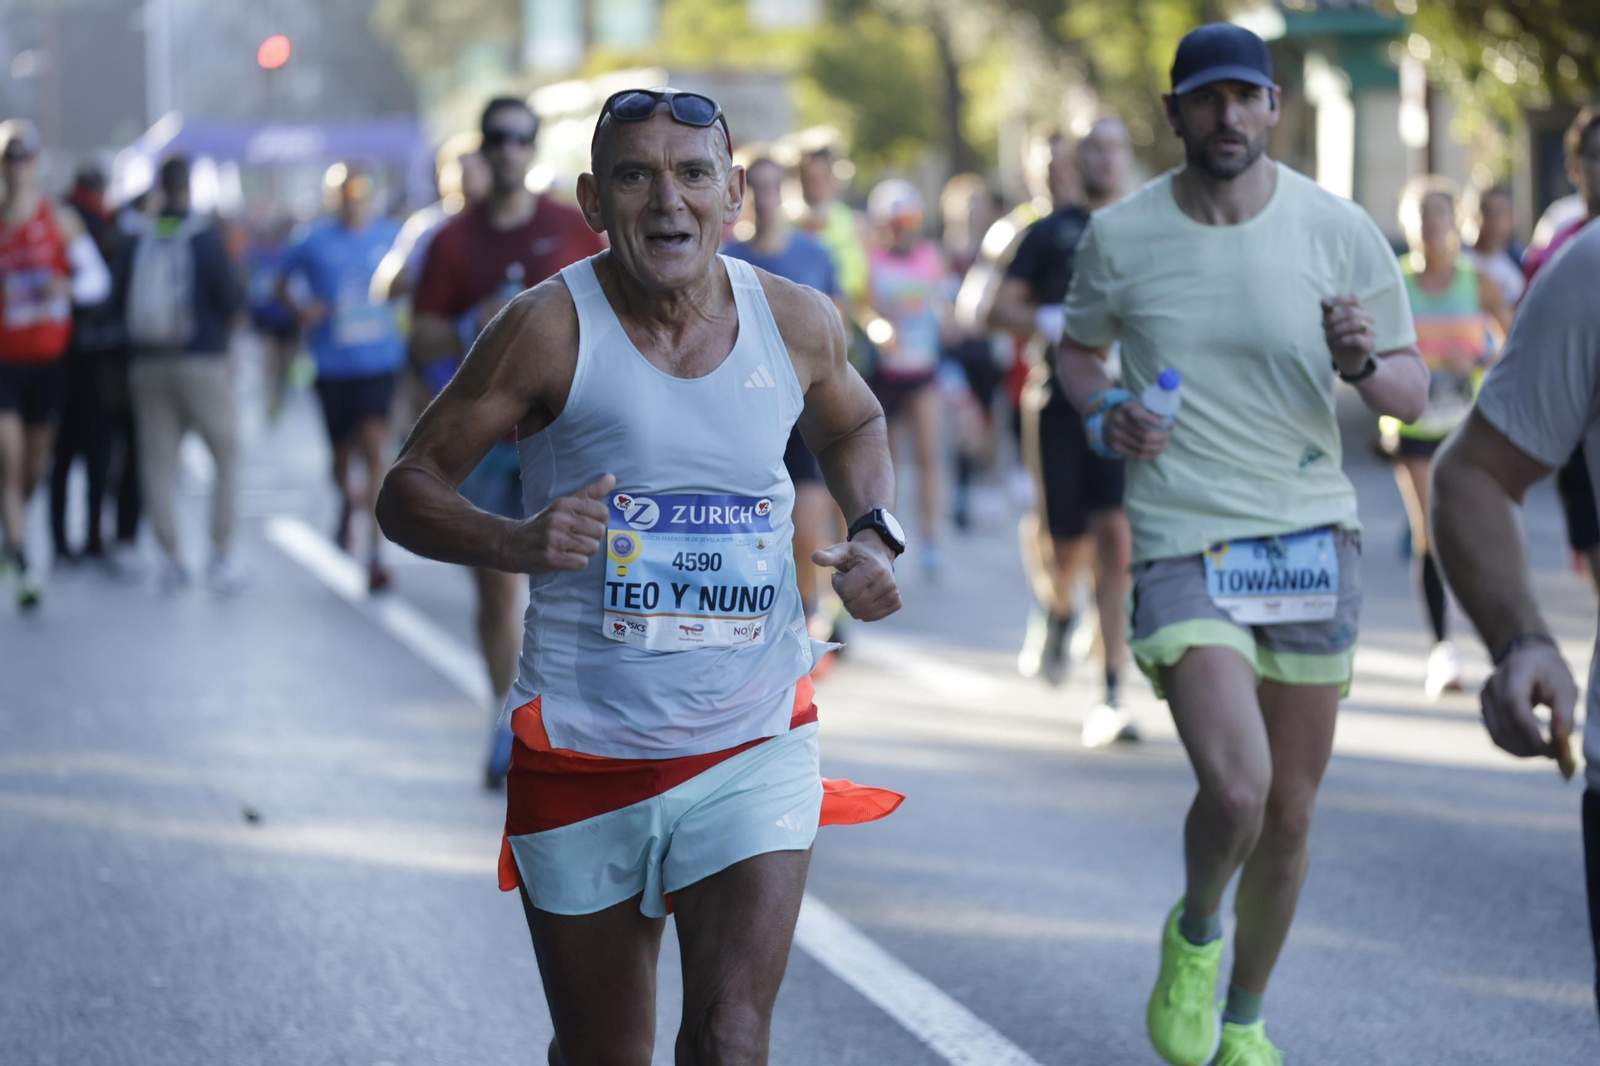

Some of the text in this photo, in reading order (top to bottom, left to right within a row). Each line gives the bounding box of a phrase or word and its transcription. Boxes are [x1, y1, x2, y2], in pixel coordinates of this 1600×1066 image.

[670, 505, 754, 525] ZURICH
[641, 534, 661, 542] ZURICH
[672, 551, 722, 572] 4590
[1215, 567, 1330, 593] TOWANDA
[606, 581, 775, 612] TEO Y NUNO
